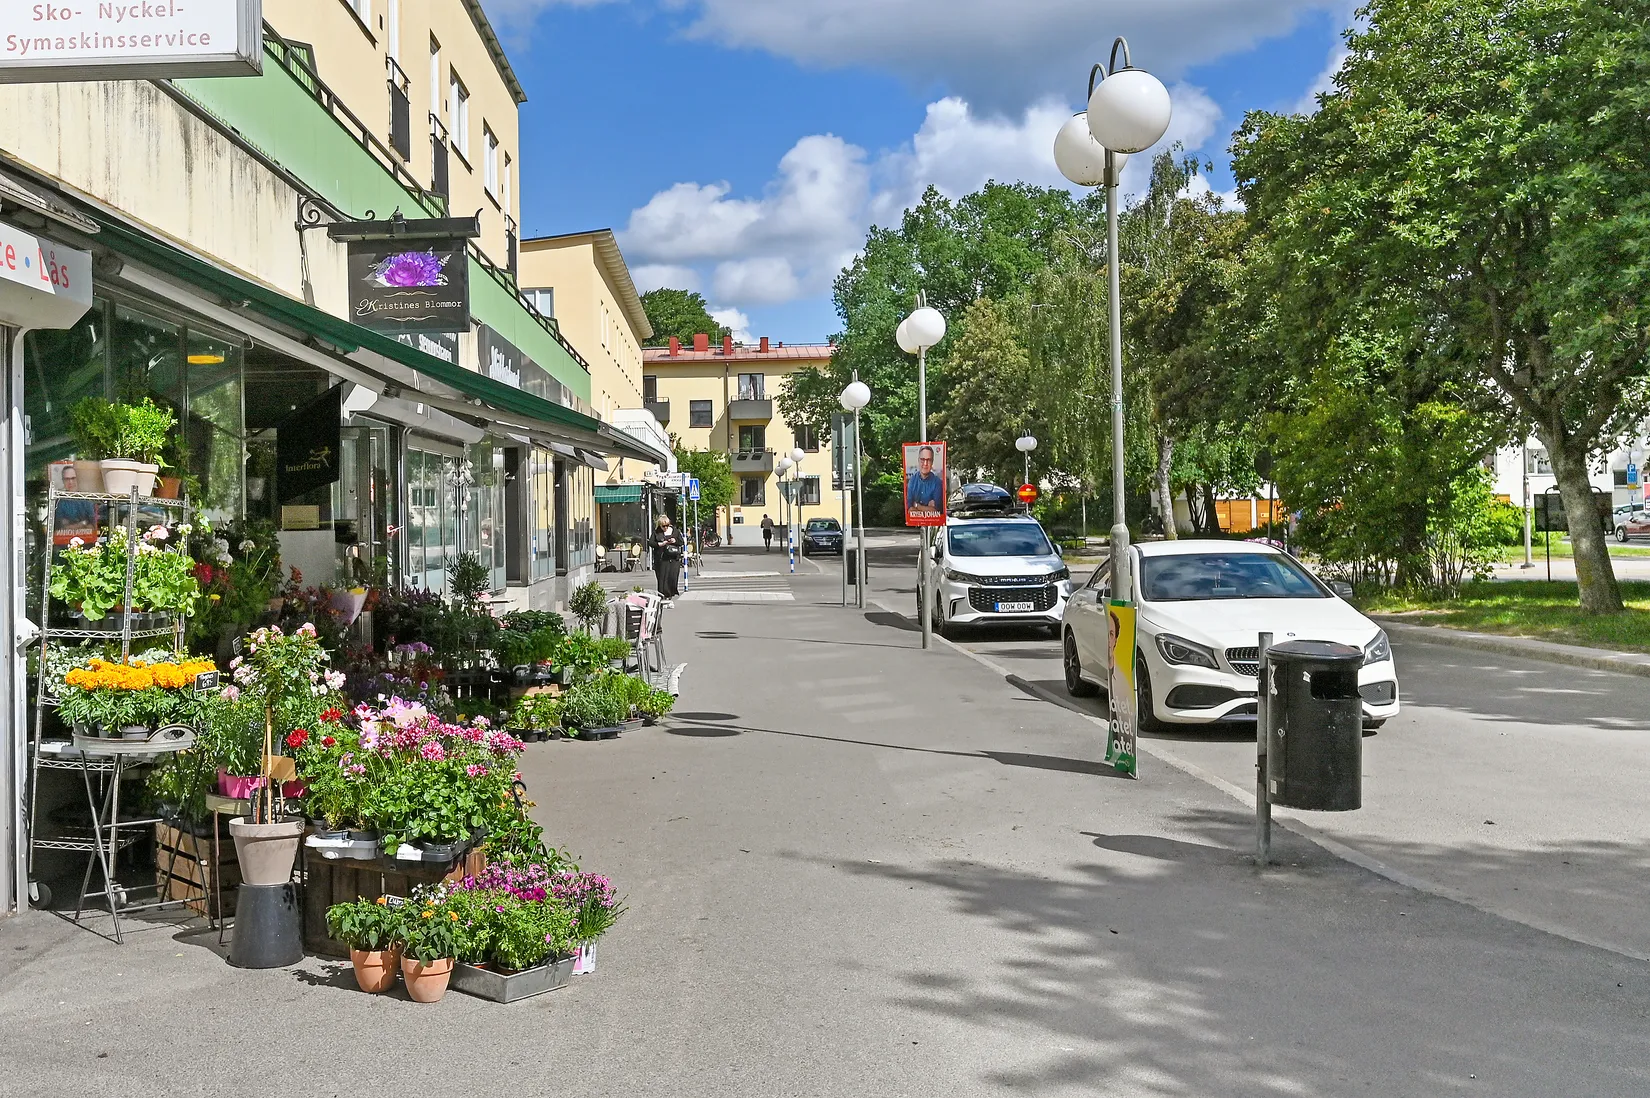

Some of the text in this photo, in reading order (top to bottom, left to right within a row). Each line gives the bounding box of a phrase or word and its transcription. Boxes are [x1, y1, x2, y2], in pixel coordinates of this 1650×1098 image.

[32, 0, 184, 23] Sko- Nyckel-
[6, 30, 211, 55] Symaskinsservice
[0, 241, 70, 288] e Lås
[355, 299, 420, 316] Kristines
[285, 462, 321, 472] Interflora
